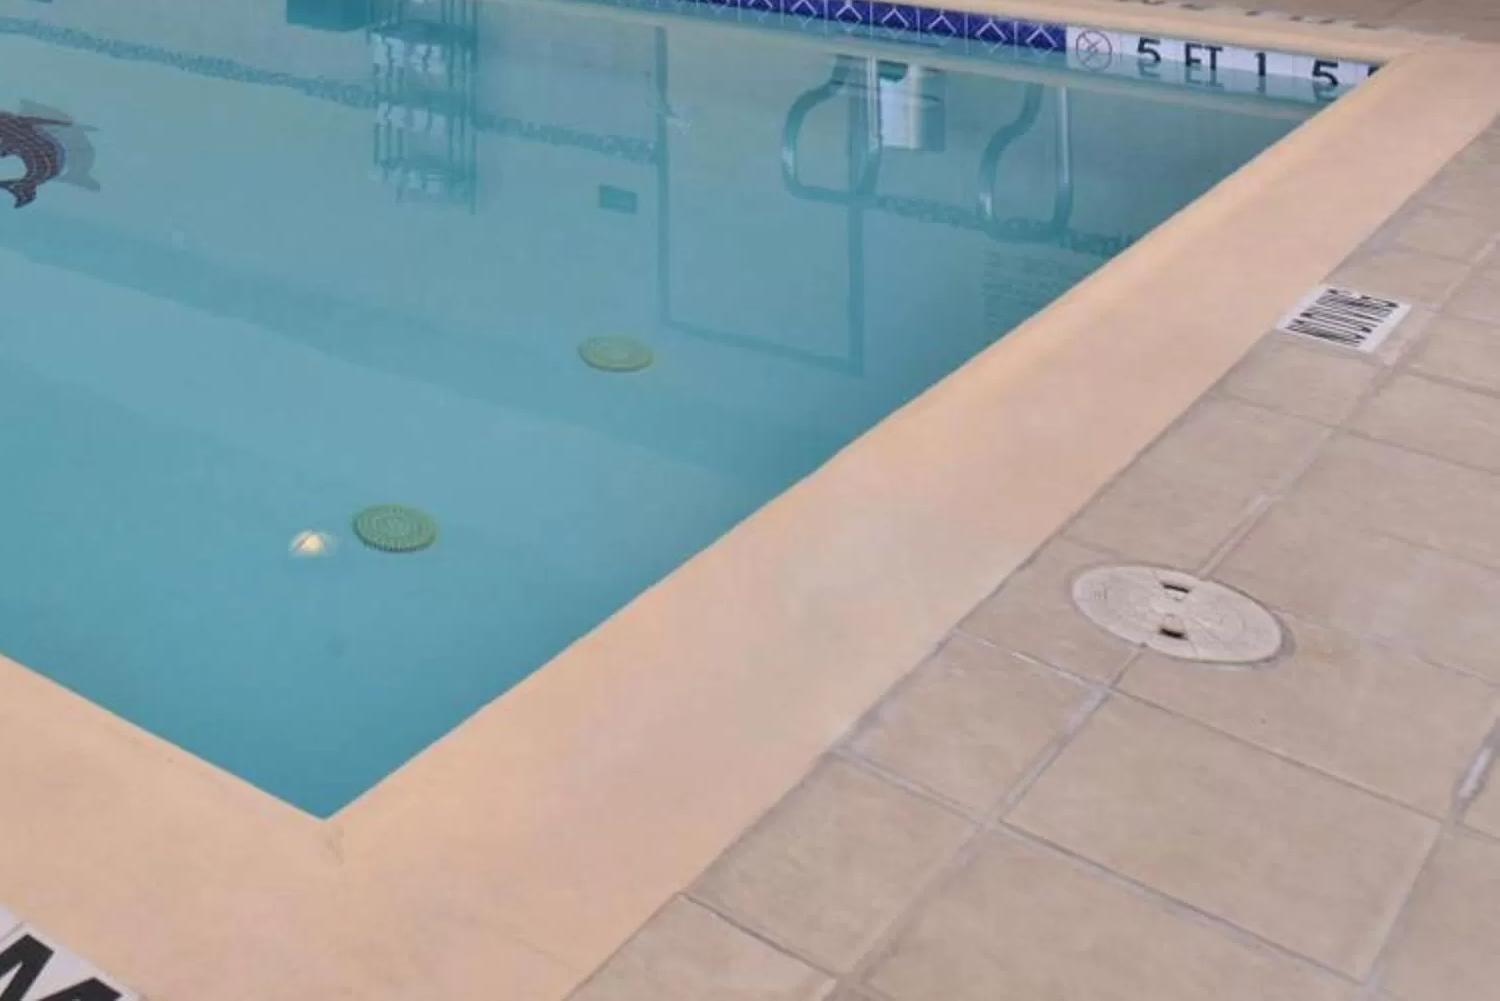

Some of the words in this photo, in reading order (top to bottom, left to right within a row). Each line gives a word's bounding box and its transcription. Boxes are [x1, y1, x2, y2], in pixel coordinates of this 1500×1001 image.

[1137, 37, 1162, 65] 5
[1184, 42, 1223, 72] FT
[1312, 60, 1340, 88] 5
